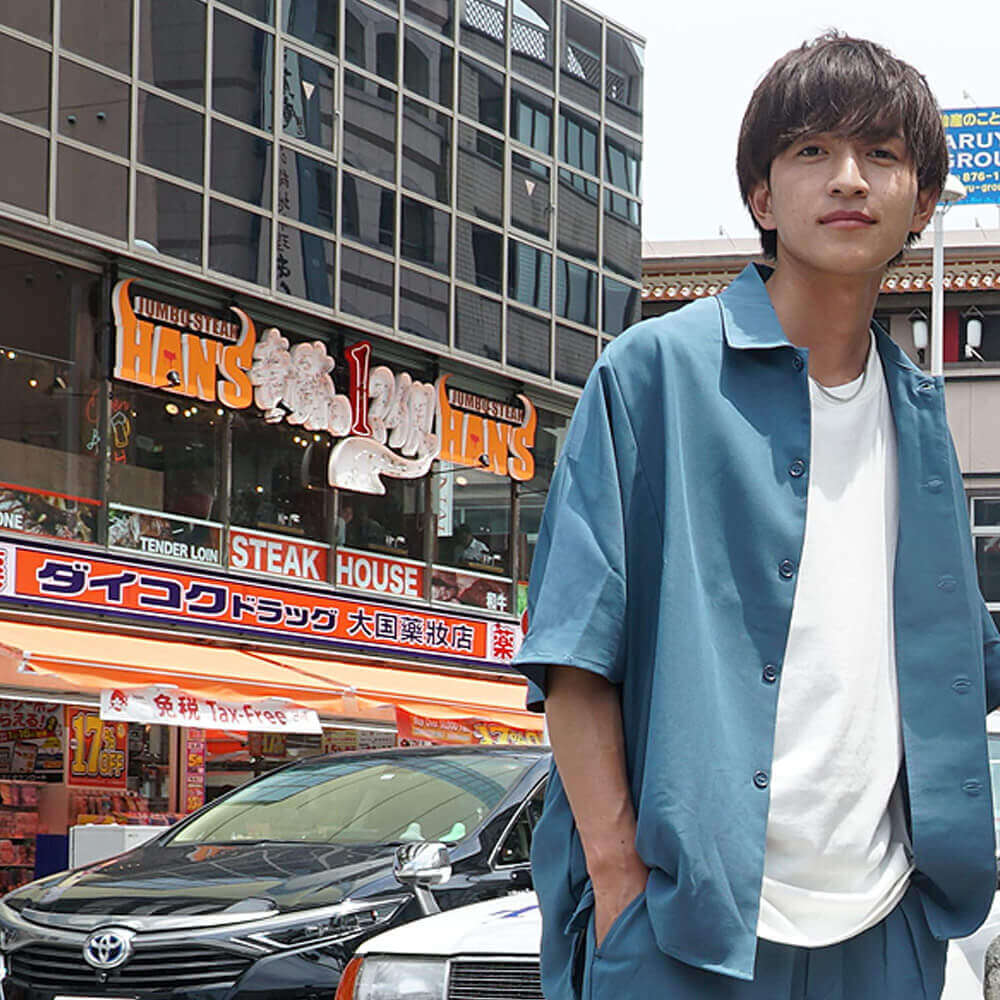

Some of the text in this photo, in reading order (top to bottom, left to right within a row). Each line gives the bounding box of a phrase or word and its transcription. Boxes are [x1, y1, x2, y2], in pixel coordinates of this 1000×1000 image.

[113, 300, 256, 410] HAN'S
[437, 390, 537, 481] HAN'S
[0, 511, 24, 530] NE
[140, 536, 218, 563] TENDER LOIN
[37, 559, 337, 632] ダイコクドラッグ
[231, 535, 420, 597] STEAK HOUSE
[153, 693, 286, 725] 免税 Tax-Free
